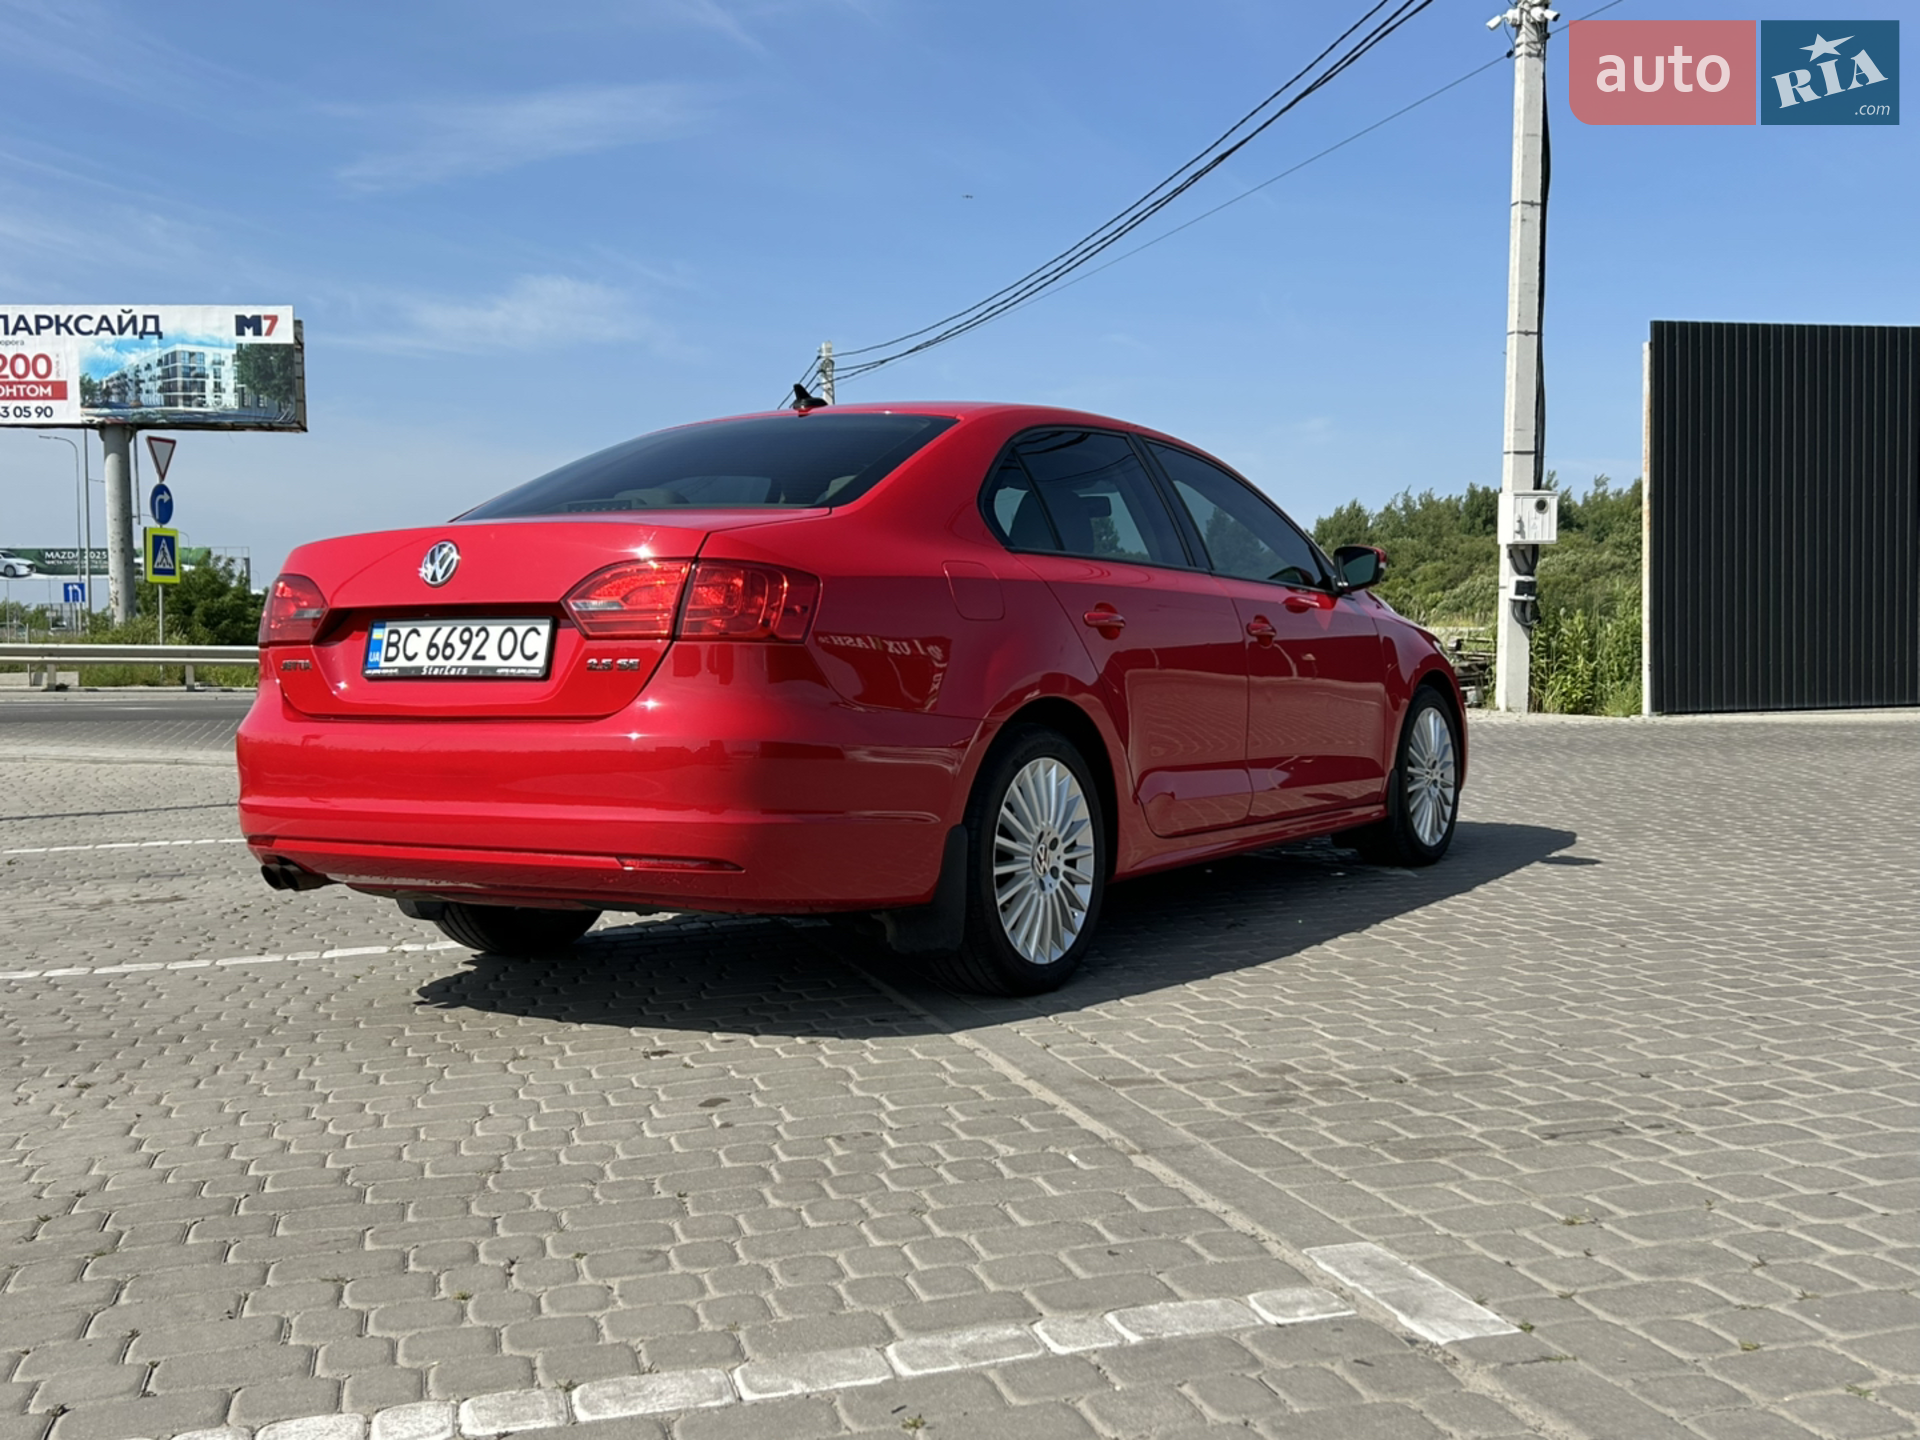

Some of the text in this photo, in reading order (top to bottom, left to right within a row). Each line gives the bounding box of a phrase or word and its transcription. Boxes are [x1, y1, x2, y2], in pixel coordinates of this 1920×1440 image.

[235, 314, 279, 336] M7
[13, 406, 32, 418] 05
[34, 406, 54, 418] 90
[384, 626, 542, 662] BC 6692 OC
[368, 651, 380, 662] UA
